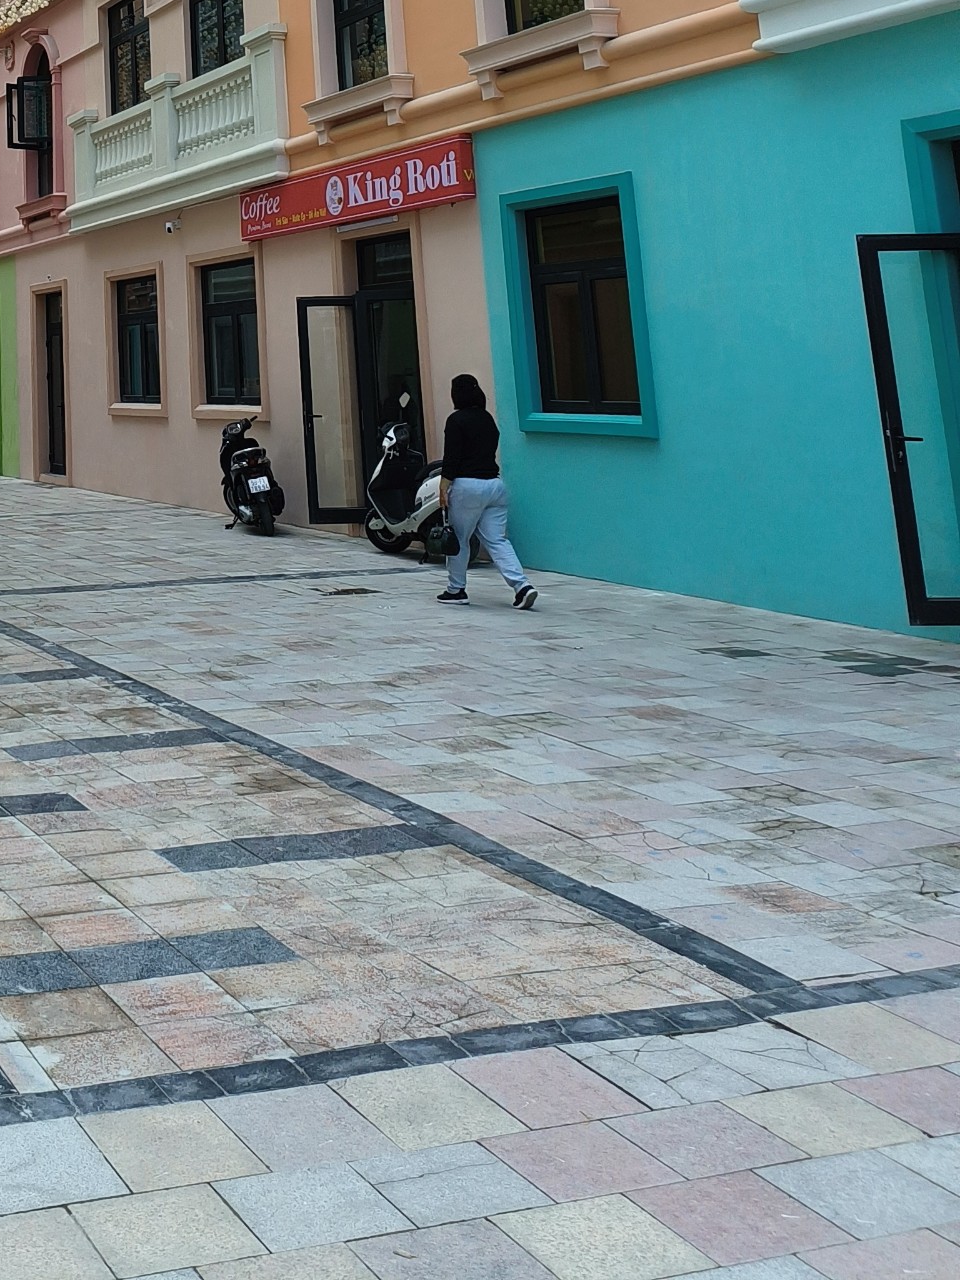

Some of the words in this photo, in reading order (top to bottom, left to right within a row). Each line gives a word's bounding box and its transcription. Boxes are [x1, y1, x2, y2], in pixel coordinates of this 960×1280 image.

[346, 166, 404, 207] King
[405, 150, 460, 195] Roti
[242, 192, 280, 221] Coffee
